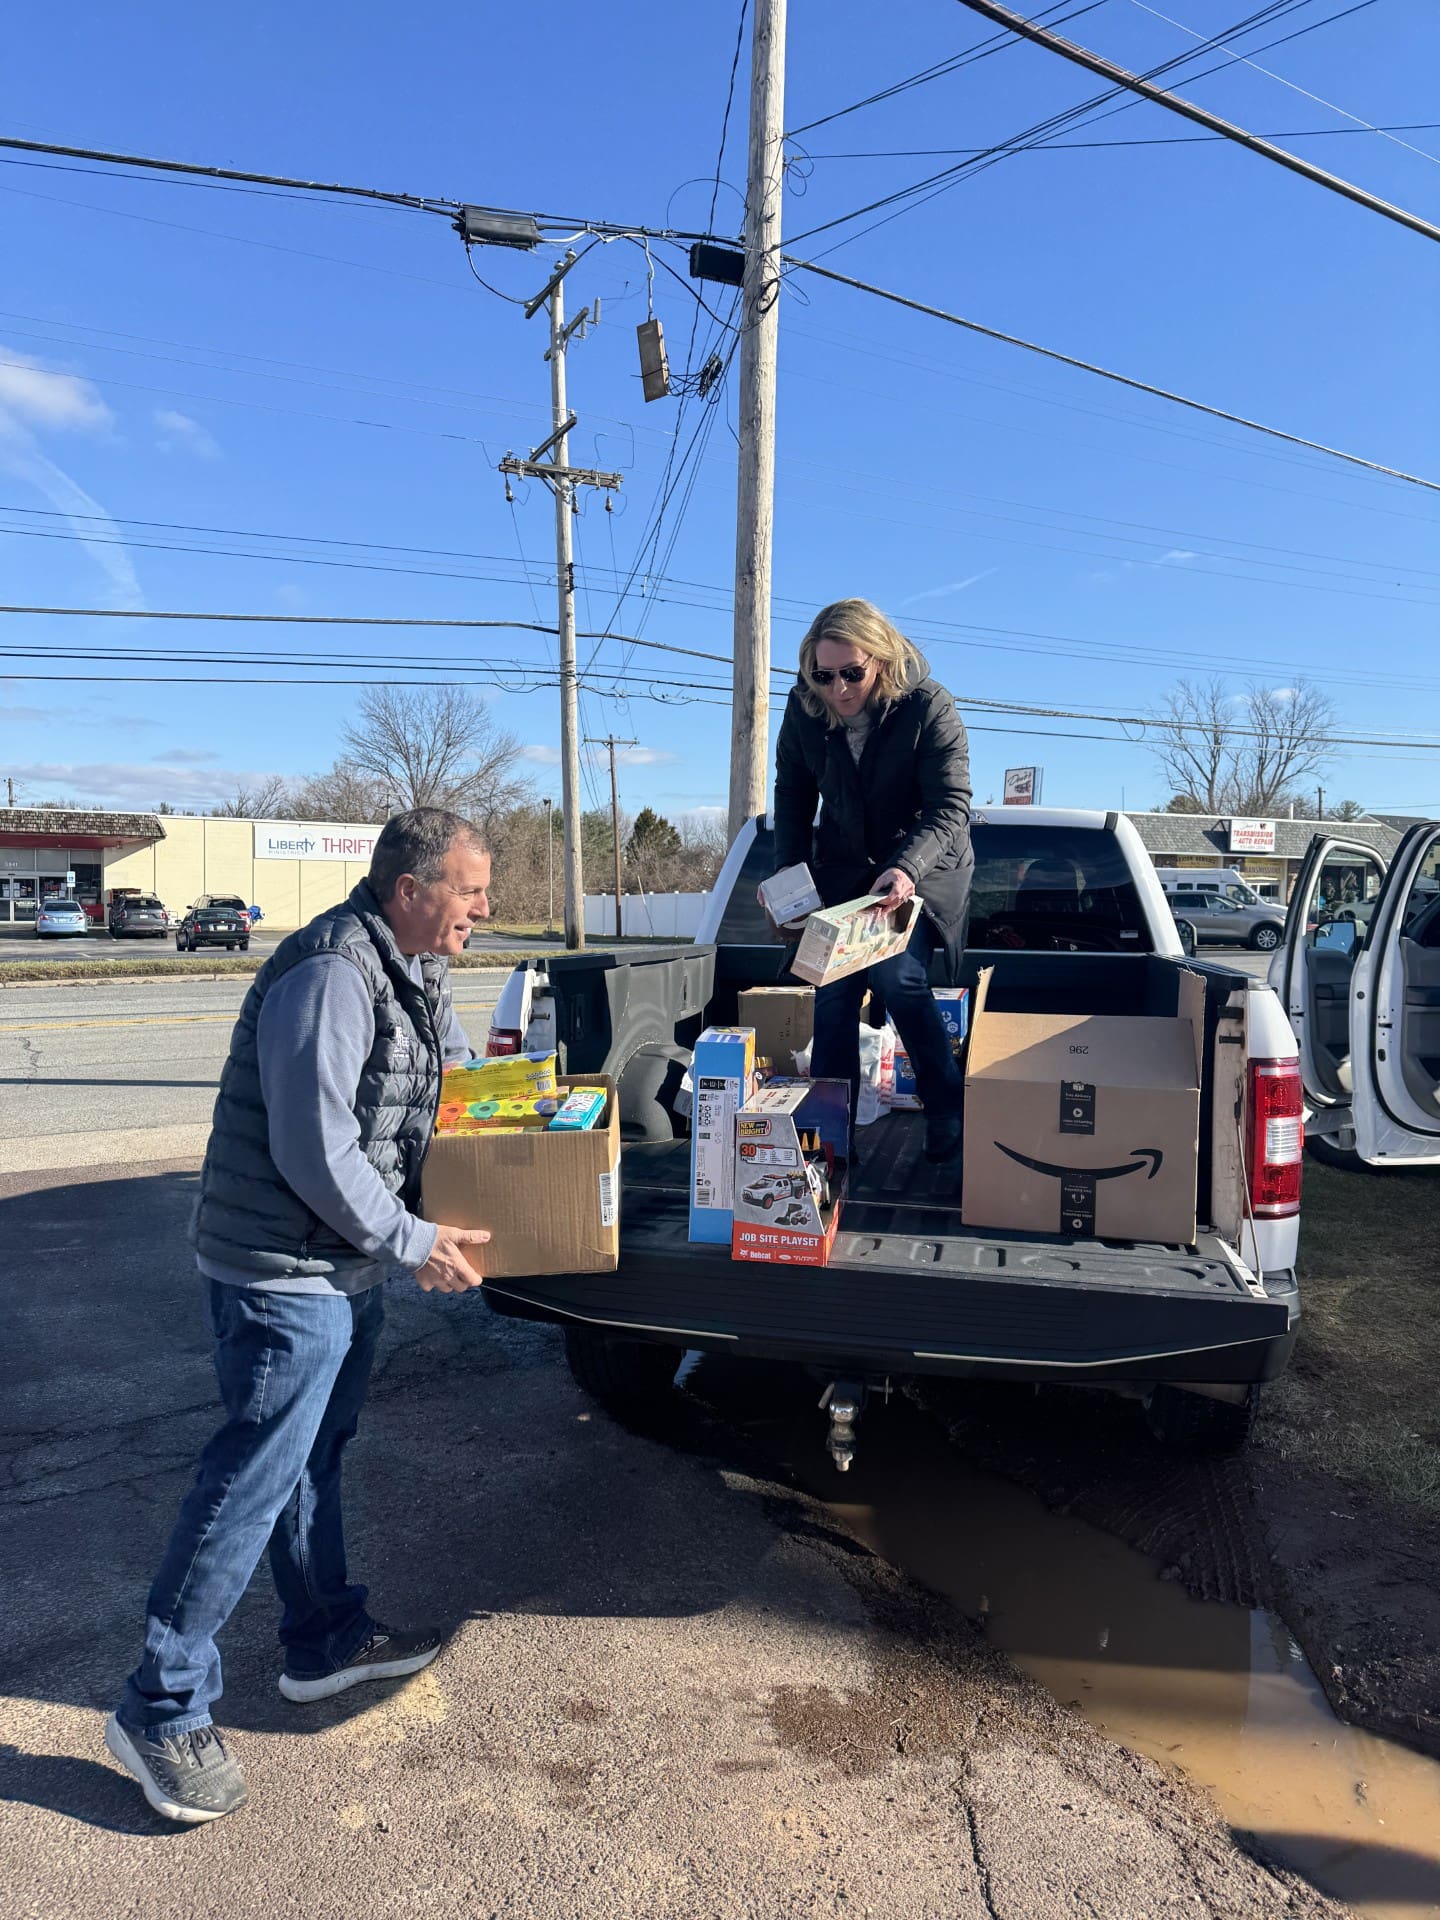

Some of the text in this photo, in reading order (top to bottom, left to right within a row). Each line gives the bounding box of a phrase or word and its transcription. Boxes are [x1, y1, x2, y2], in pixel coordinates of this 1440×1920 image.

[1233, 830, 1274, 838] TRANSMISSION
[268, 837, 375, 855] LIBERTY THRIFT
[1069, 1045, 1088, 1055] 296
[741, 1144, 757, 1158] 30
[740, 1232, 757, 1242] JOB
[760, 1234, 779, 1244] SITE
[781, 1235, 820, 1247] PLAYSET
